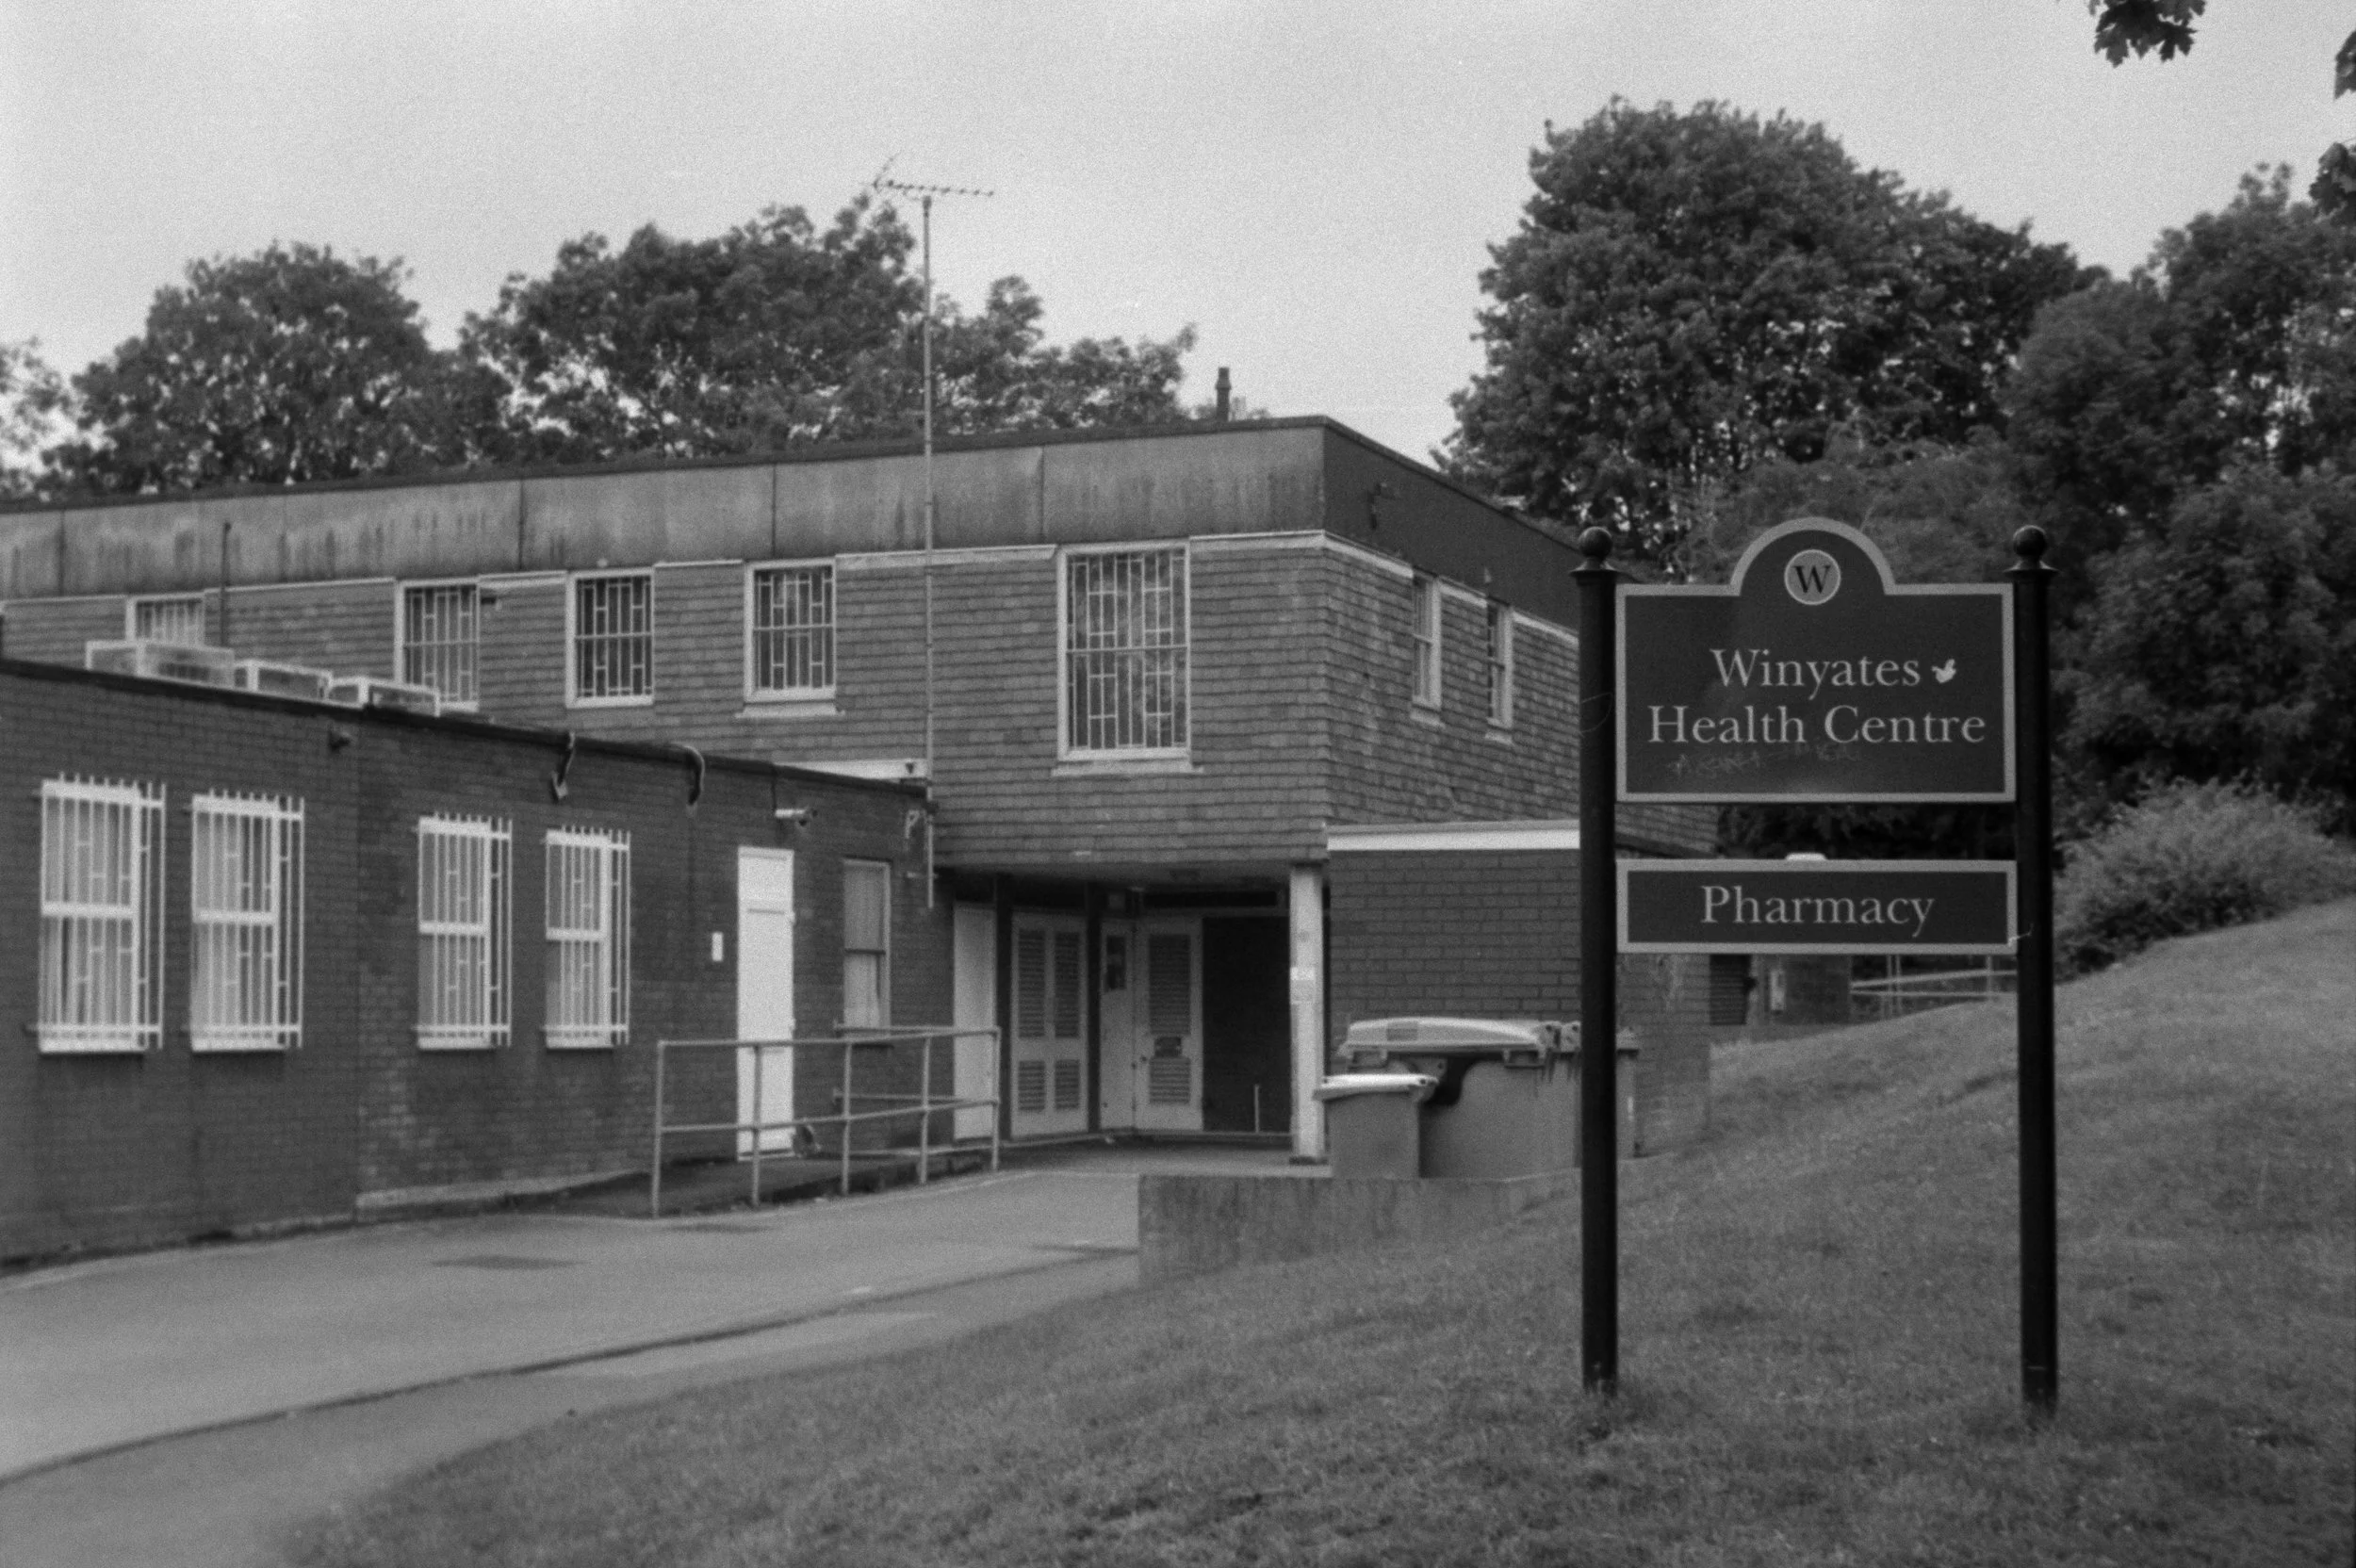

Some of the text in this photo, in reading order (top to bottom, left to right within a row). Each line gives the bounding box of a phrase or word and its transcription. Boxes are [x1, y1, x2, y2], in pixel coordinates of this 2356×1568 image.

[1792, 564, 1832, 595] W
[1710, 648, 1922, 701] Winyates
[1646, 704, 1987, 743] Health Centre
[1700, 884, 1936, 939] Pharmacy
